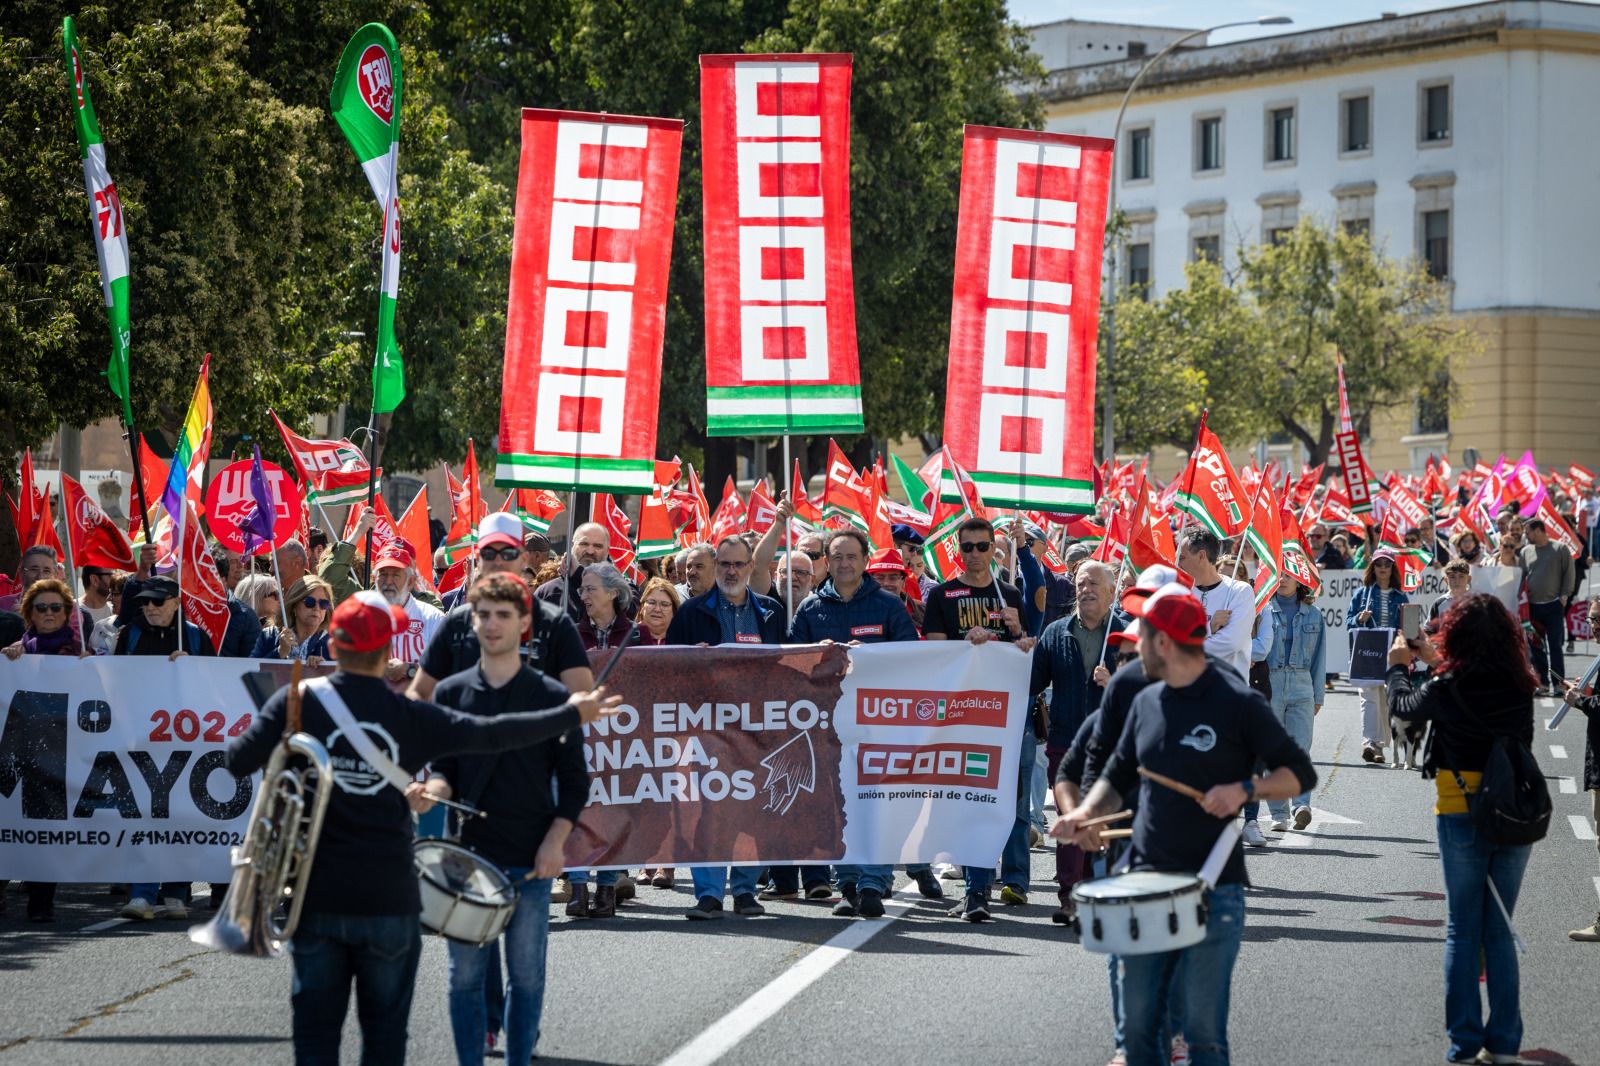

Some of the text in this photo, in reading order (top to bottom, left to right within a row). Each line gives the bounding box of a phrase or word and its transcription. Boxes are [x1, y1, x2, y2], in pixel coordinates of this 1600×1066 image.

[734, 62, 829, 381] CCOO
[534, 119, 648, 456] CCOO
[977, 138, 1081, 477] CCOO
[1339, 434, 1367, 502] CCOO
[1390, 485, 1424, 524] CCOO
[958, 597, 990, 628] GUNS
[653, 700, 829, 733] EMPLEO:
[864, 697, 1002, 718] UGT Andalucía
[863, 751, 962, 775] CCOO
[858, 789, 997, 804] unión provincial de Cádiz
[0, 829, 110, 846] ENOEMPLEO
